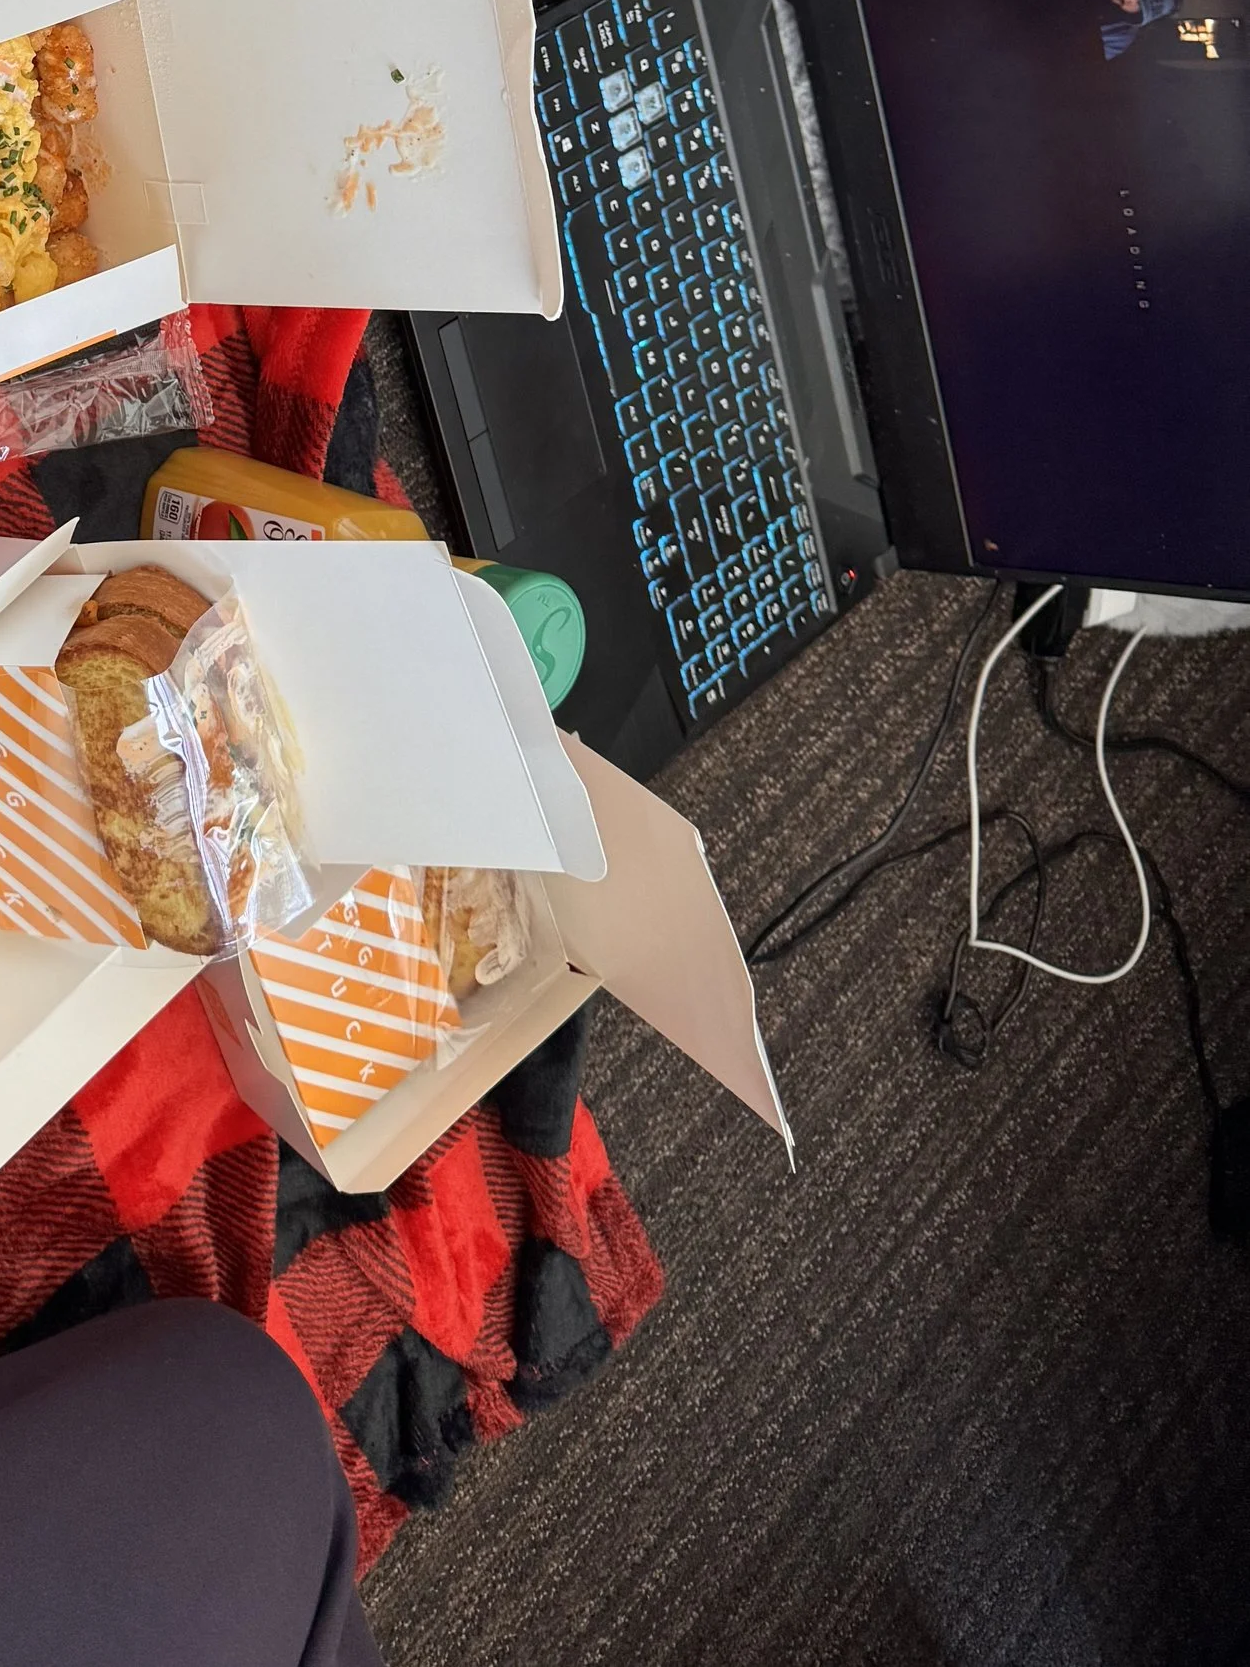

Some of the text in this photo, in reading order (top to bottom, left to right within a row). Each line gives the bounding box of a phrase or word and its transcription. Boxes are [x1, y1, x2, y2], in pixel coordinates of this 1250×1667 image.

[597, 23, 609, 49] LOCK
[1120, 190, 1150, 308] LOADING
[169, 500, 180, 521] 160
[317, 934, 376, 1083] TUCK
